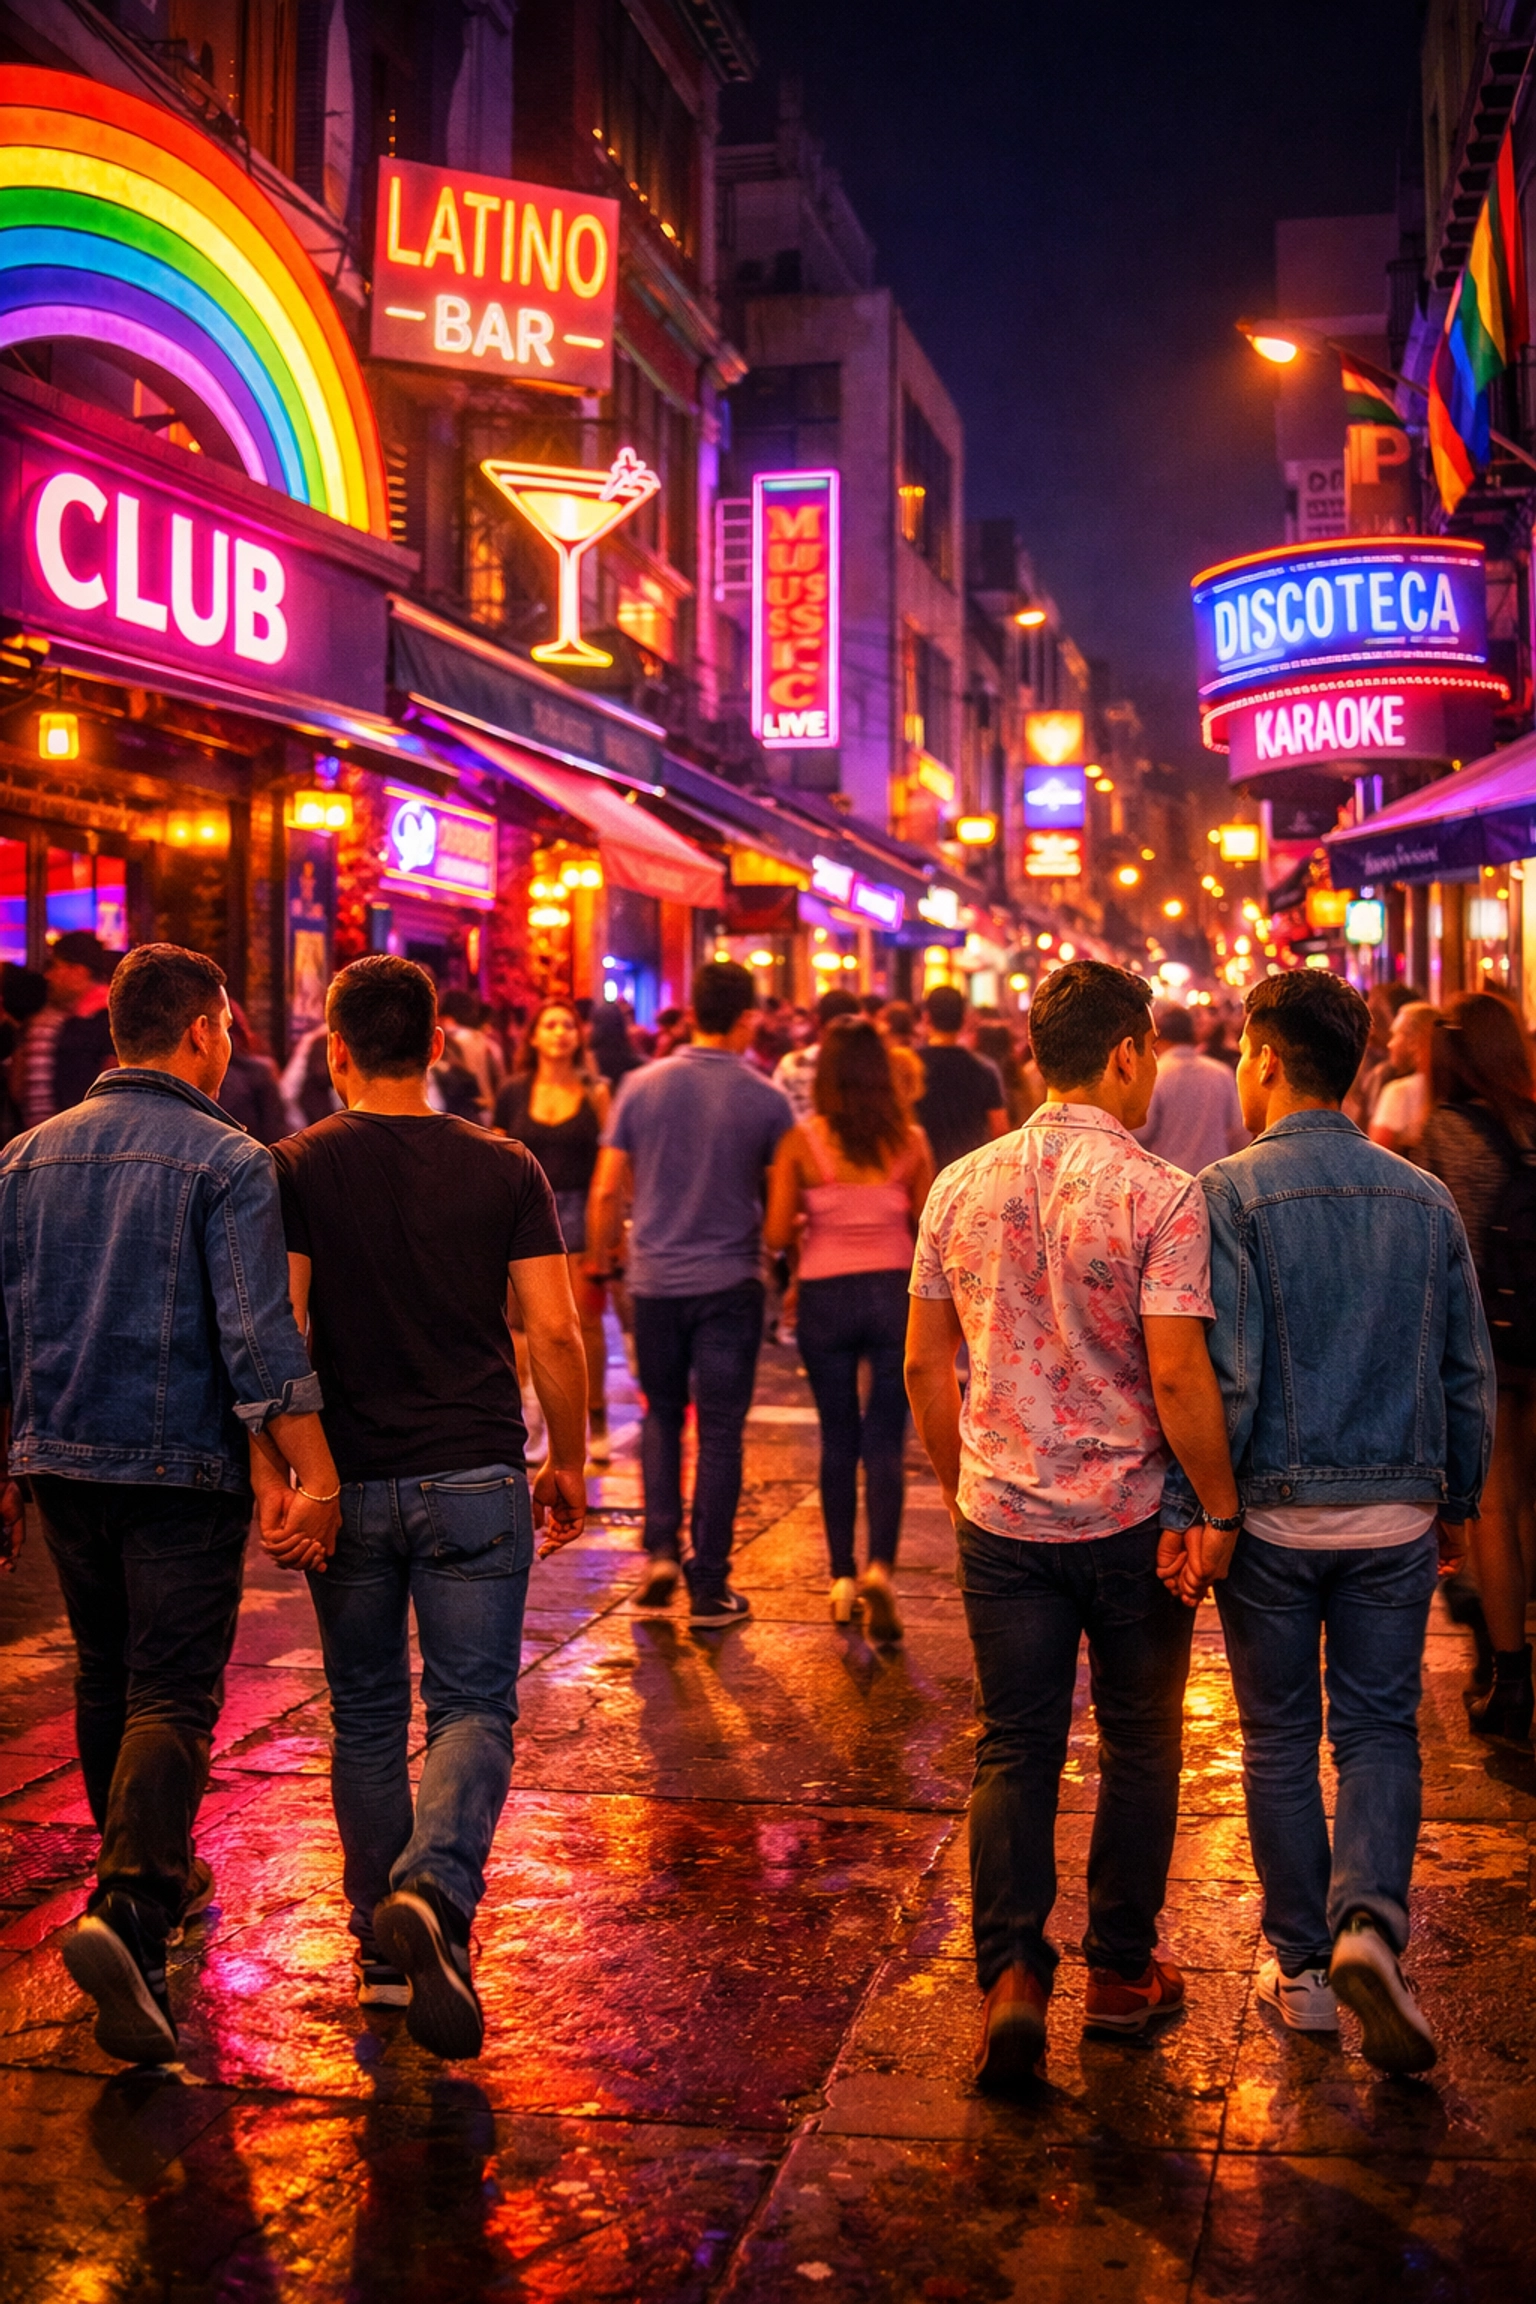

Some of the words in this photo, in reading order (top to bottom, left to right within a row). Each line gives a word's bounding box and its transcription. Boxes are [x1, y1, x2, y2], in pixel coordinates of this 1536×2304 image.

[387, 176, 608, 299] LATINO
[434, 293, 555, 368] BAR
[34, 471, 289, 666] CLUB
[1213, 570, 1461, 662] DISCOTECA
[763, 710, 828, 738] LIVE
[1254, 695, 1406, 761] KARAOKE
